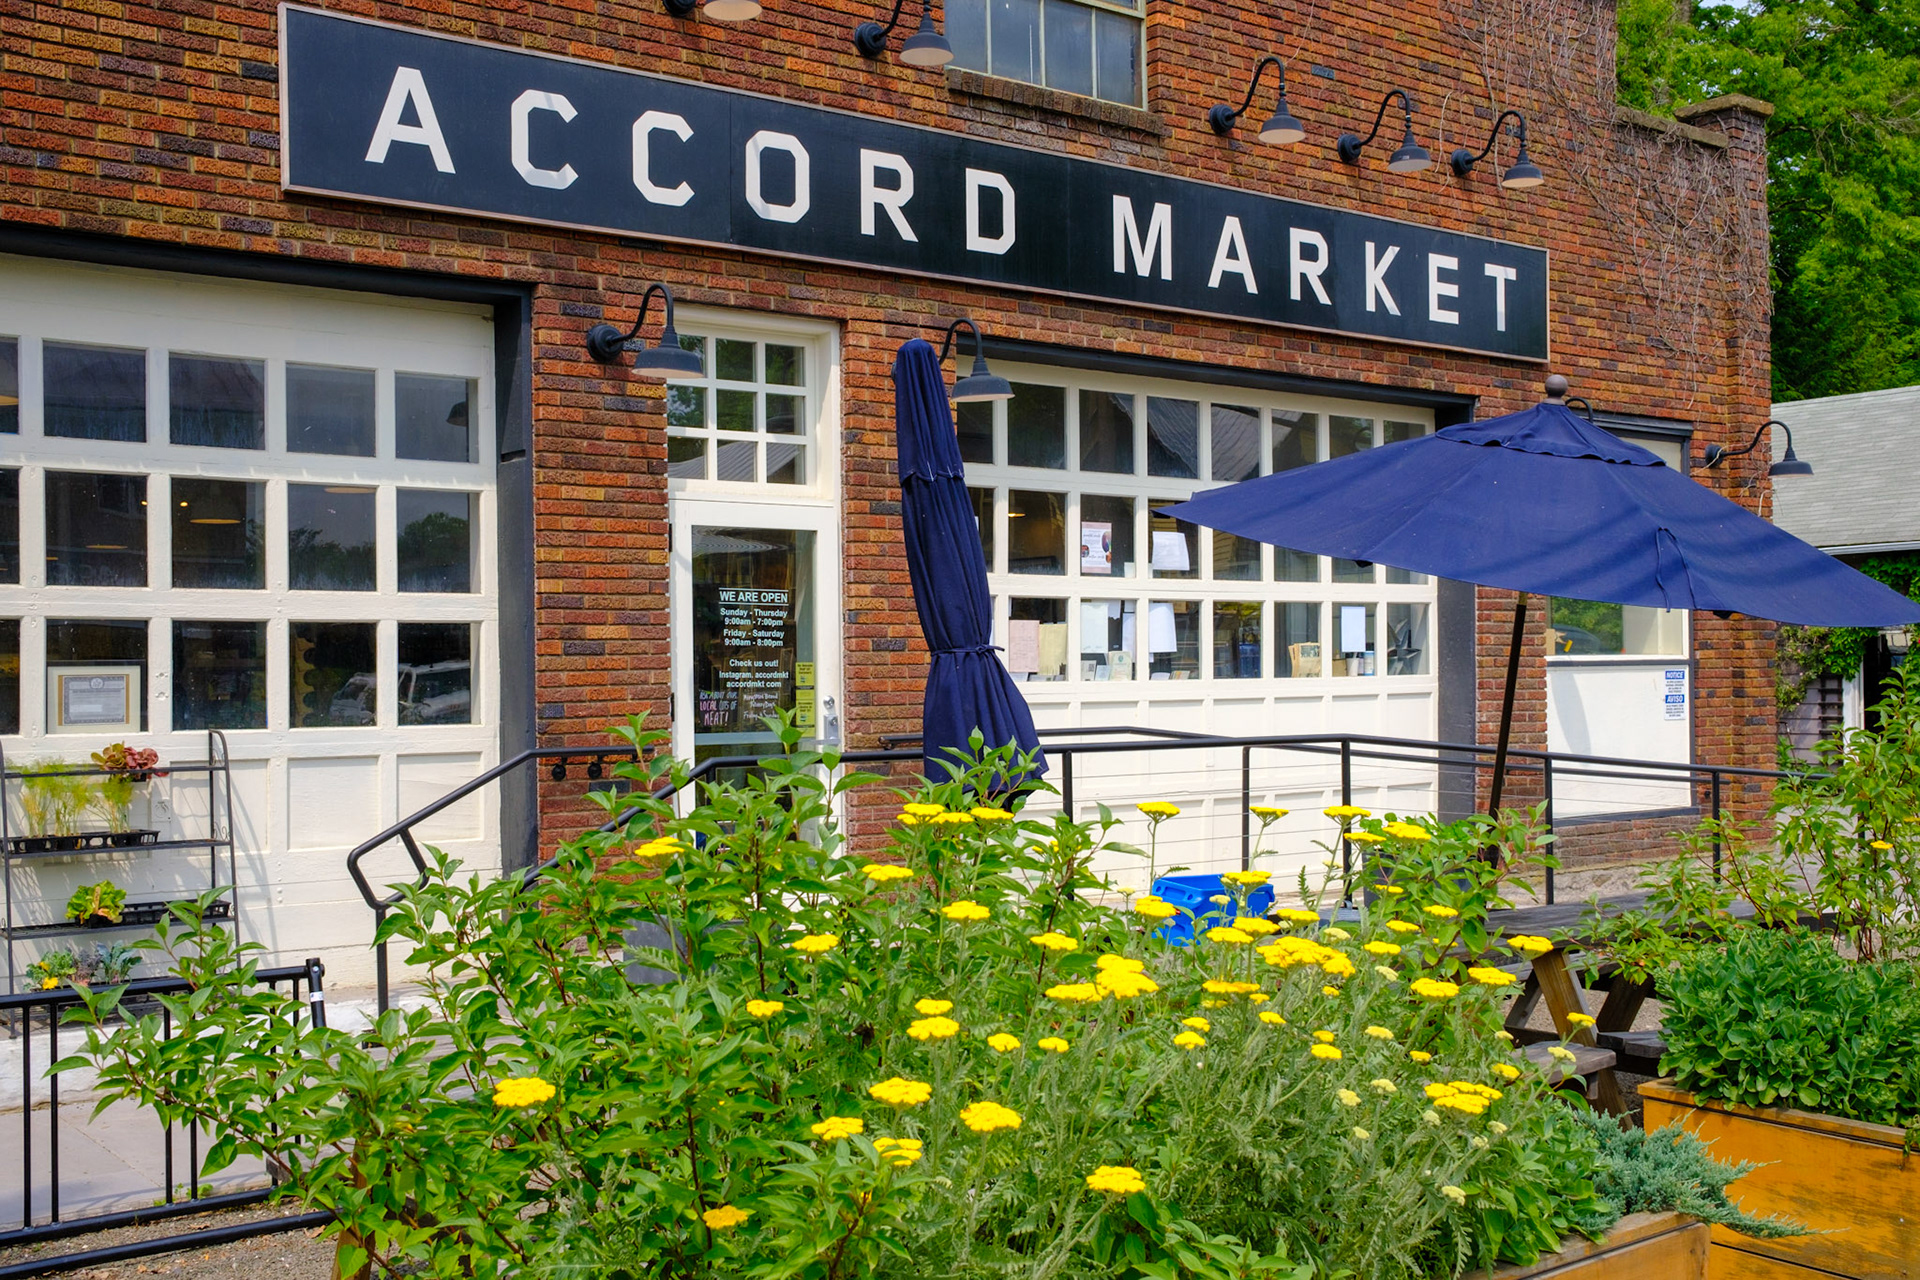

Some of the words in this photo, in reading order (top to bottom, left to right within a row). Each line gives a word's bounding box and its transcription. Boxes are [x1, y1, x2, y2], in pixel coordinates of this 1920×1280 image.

[365, 66, 1015, 255] ACCORD
[1112, 194, 1517, 332] MARKET
[719, 591, 736, 602] WE
[738, 592, 758, 602] ARE
[760, 592, 788, 603] OPEN
[720, 608, 748, 618] Sunday
[754, 609, 788, 619] Thursday
[724, 617, 752, 626] 9:00am
[757, 618, 784, 628] 7:00pm
[723, 629, 746, 639] Friday
[753, 629, 785, 640] Saturday
[724, 638, 752, 647] 9:00am
[757, 638, 784, 649] 8:00pm
[729, 659, 753, 667] Check
[1666, 671, 1684, 679] NOTICE
[1667, 695, 1684, 703] AVISO
[699, 700, 717, 711] LOCAL
[704, 711, 729, 727] MEAT!
